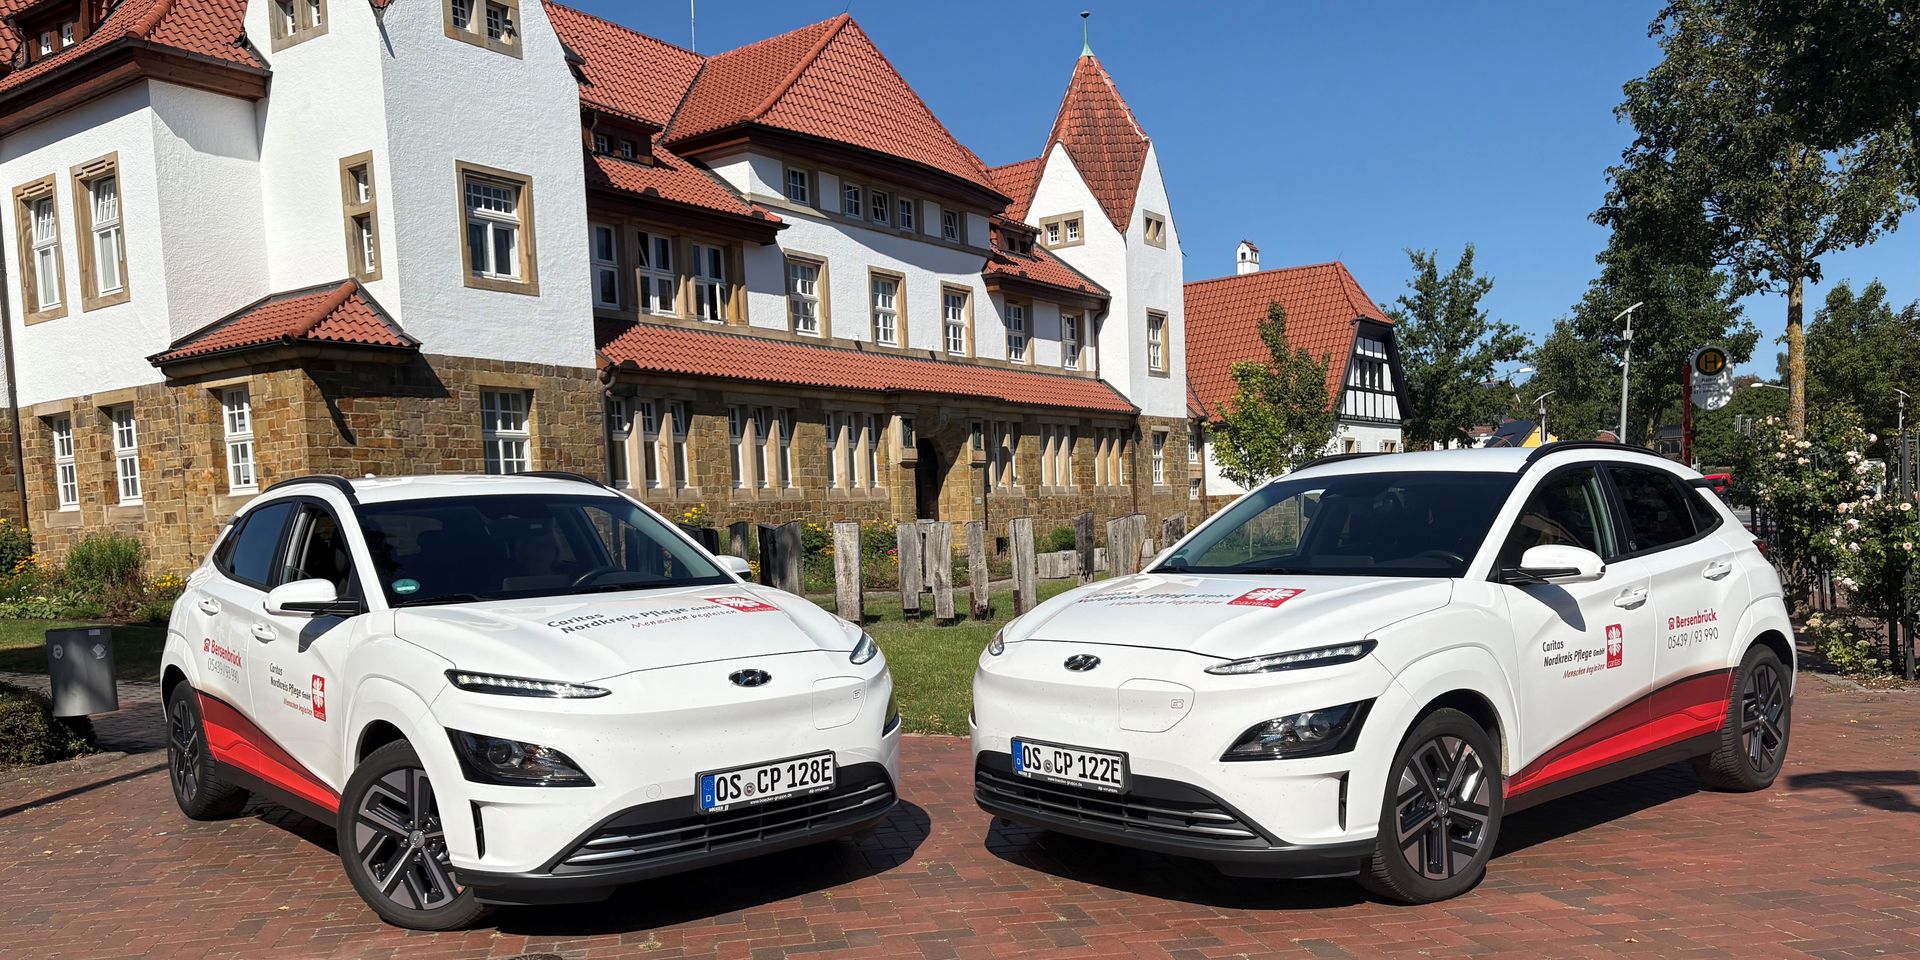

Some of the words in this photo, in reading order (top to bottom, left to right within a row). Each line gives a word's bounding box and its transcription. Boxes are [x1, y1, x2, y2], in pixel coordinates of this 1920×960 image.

[1704, 354, 1718, 370] H
[547, 613, 604, 628] Caritas
[561, 614, 639, 634] Nordkreis
[640, 607, 688, 618] Pflege
[631, 615, 688, 629] Menschen
[690, 609, 737, 619] begleiten
[1676, 607, 1718, 629] Bersenbrück
[1542, 640, 1564, 653] Caritas
[1667, 633, 1688, 650] 05439
[1694, 629, 1702, 643] 93
[1704, 627, 1719, 641] 990
[211, 639, 242, 668] Bersenbrück
[1543, 652, 1573, 668] Nordkreis
[1573, 648, 1592, 663] Pflege
[1592, 647, 1606, 657] GmbH
[269, 662, 283, 677] Caritas
[1562, 667, 1586, 680] Menschen
[1585, 663, 1606, 676] begleiten
[270, 675, 289, 692] Nordkreis
[288, 683, 302, 699] Pflege
[1022, 745, 1041, 771] OS
[1053, 750, 1073, 776] CP
[1077, 754, 1121, 785] 122E
[705, 794, 712, 803] D
[715, 773, 742, 802] OS
[757, 767, 782, 795] CP
[786, 757, 833, 789] 128E
